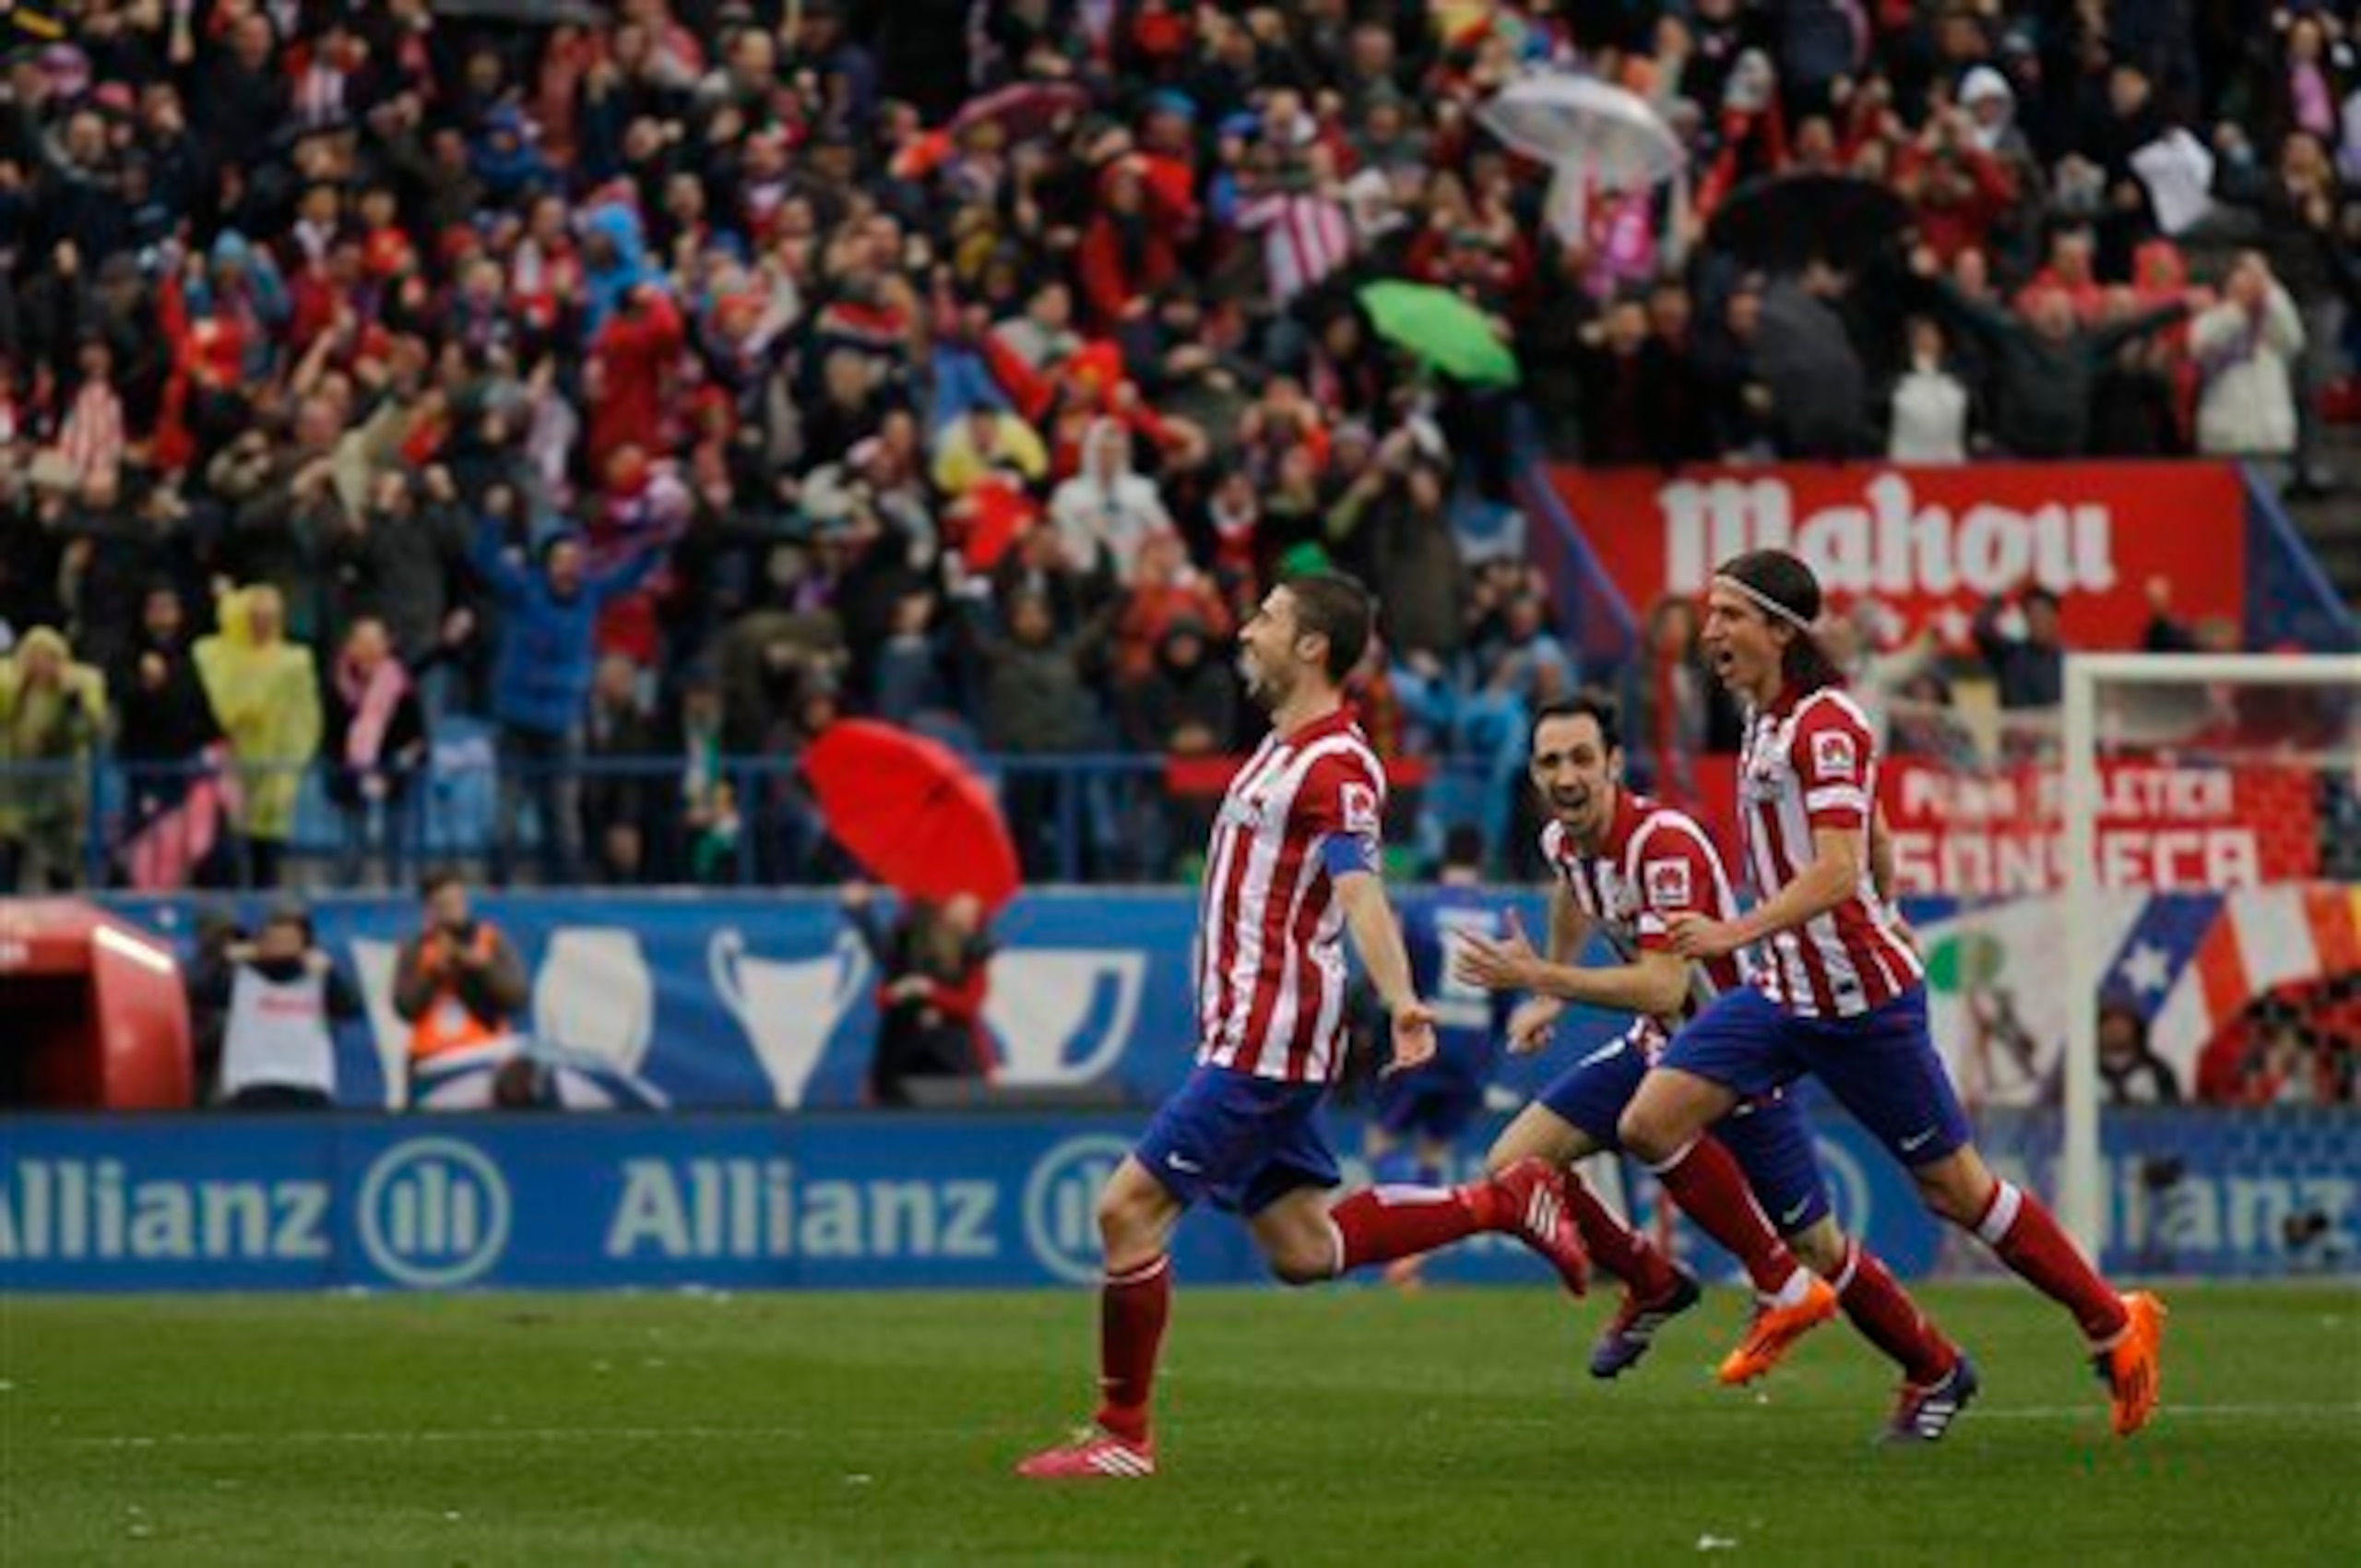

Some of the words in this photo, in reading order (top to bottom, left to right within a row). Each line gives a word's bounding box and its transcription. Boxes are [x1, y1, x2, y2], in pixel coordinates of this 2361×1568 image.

[1658, 472, 2115, 597] Mahou
[2036, 769, 2234, 817] ALETICA
[0, 1160, 329, 1257] llianz
[608, 1158, 997, 1255] Allianz
[1992, 1155, 2355, 1251] lianz
